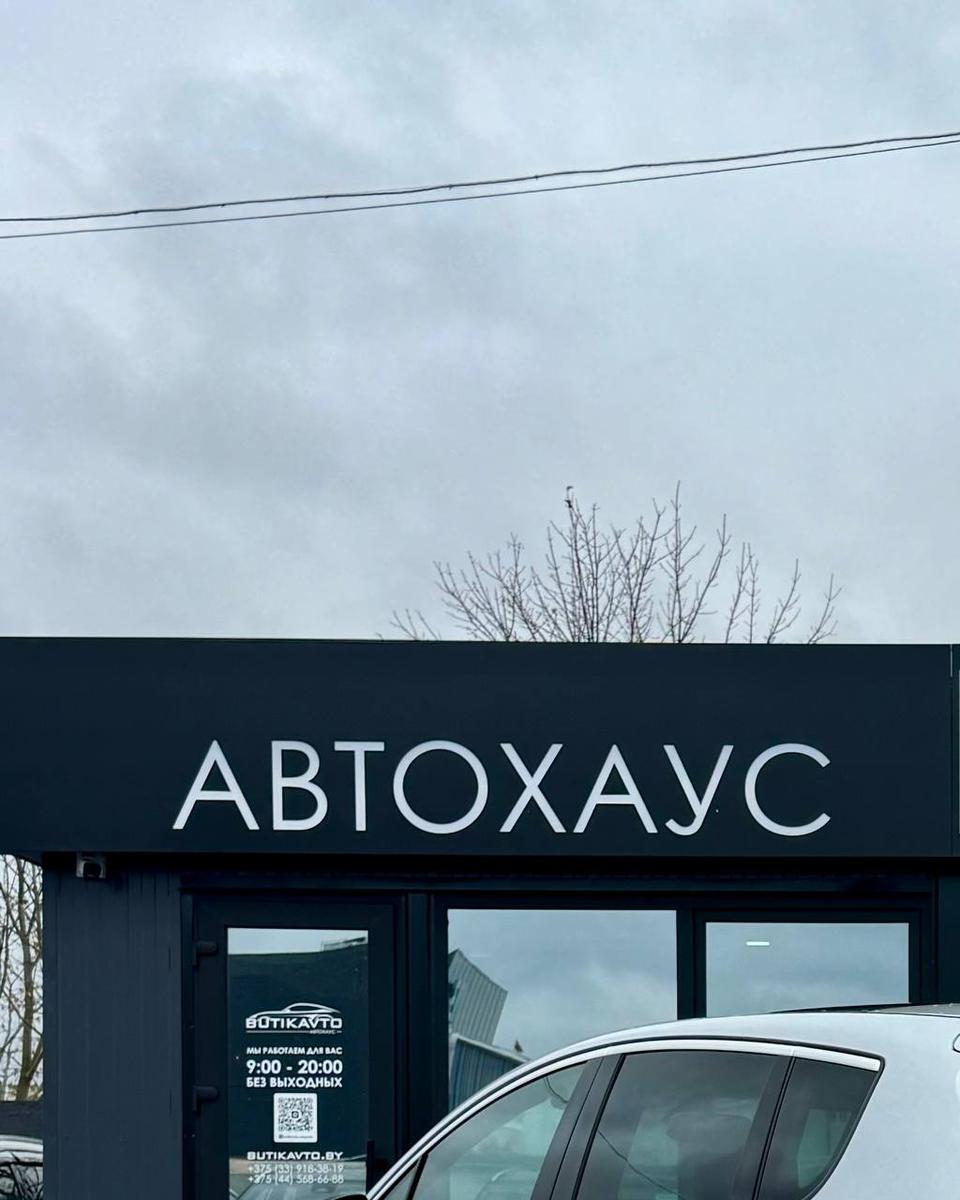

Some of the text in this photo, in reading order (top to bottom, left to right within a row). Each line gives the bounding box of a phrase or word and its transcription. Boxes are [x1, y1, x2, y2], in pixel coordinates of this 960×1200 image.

[172, 740, 831, 836] АВТОХАУС
[245, 1017, 343, 1029] BUTIKAVTO
[246, 1060, 281, 1074] 9:00
[298, 1060, 343, 1074] 20:00
[246, 1077, 343, 1089] БЕЗ ВЫХОДНЫХ
[247, 1152, 344, 1160] BUTIKAVTO.BY
[248, 1164, 272, 1174] +375
[275, 1164, 293, 1176] (33)
[275, 1174, 293, 1186] (44)
